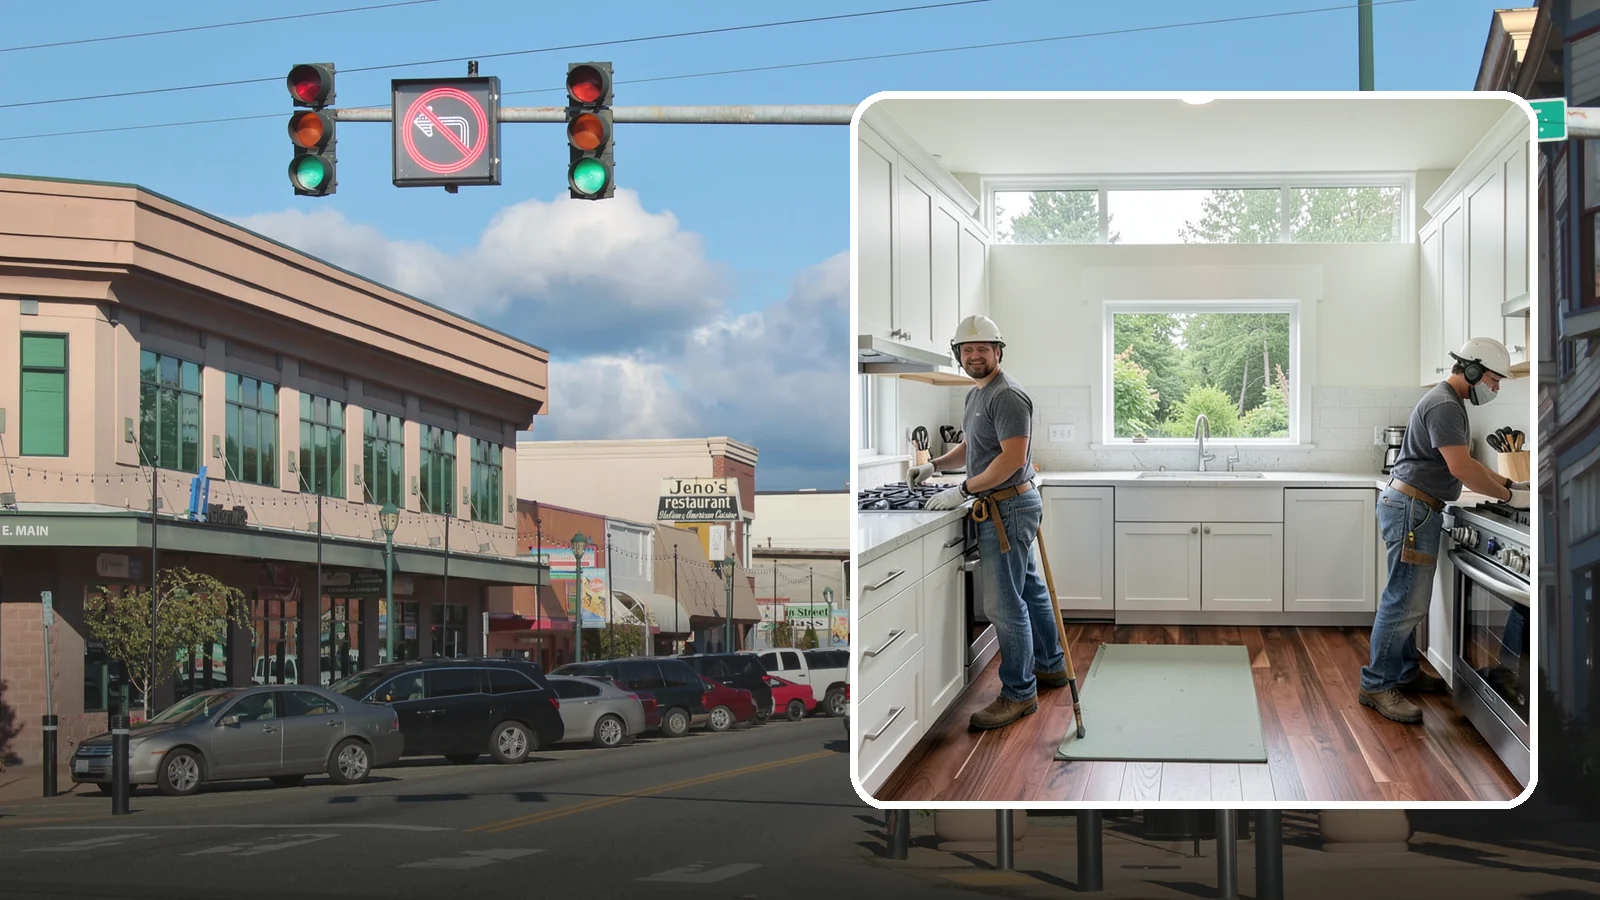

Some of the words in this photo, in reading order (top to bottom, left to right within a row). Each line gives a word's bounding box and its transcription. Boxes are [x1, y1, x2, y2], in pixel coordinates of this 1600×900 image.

[670, 480, 727, 494] Jeno's
[665, 496, 731, 509] restaurant
[659, 510, 682, 520] Italian
[686, 510, 714, 520] American
[715, 510, 737, 520] Cuisine
[2, 525, 13, 536] E.
[15, 525, 49, 536] MAIN
[786, 608, 794, 616] in
[797, 607, 828, 616] Street
[791, 619, 824, 627] lass
